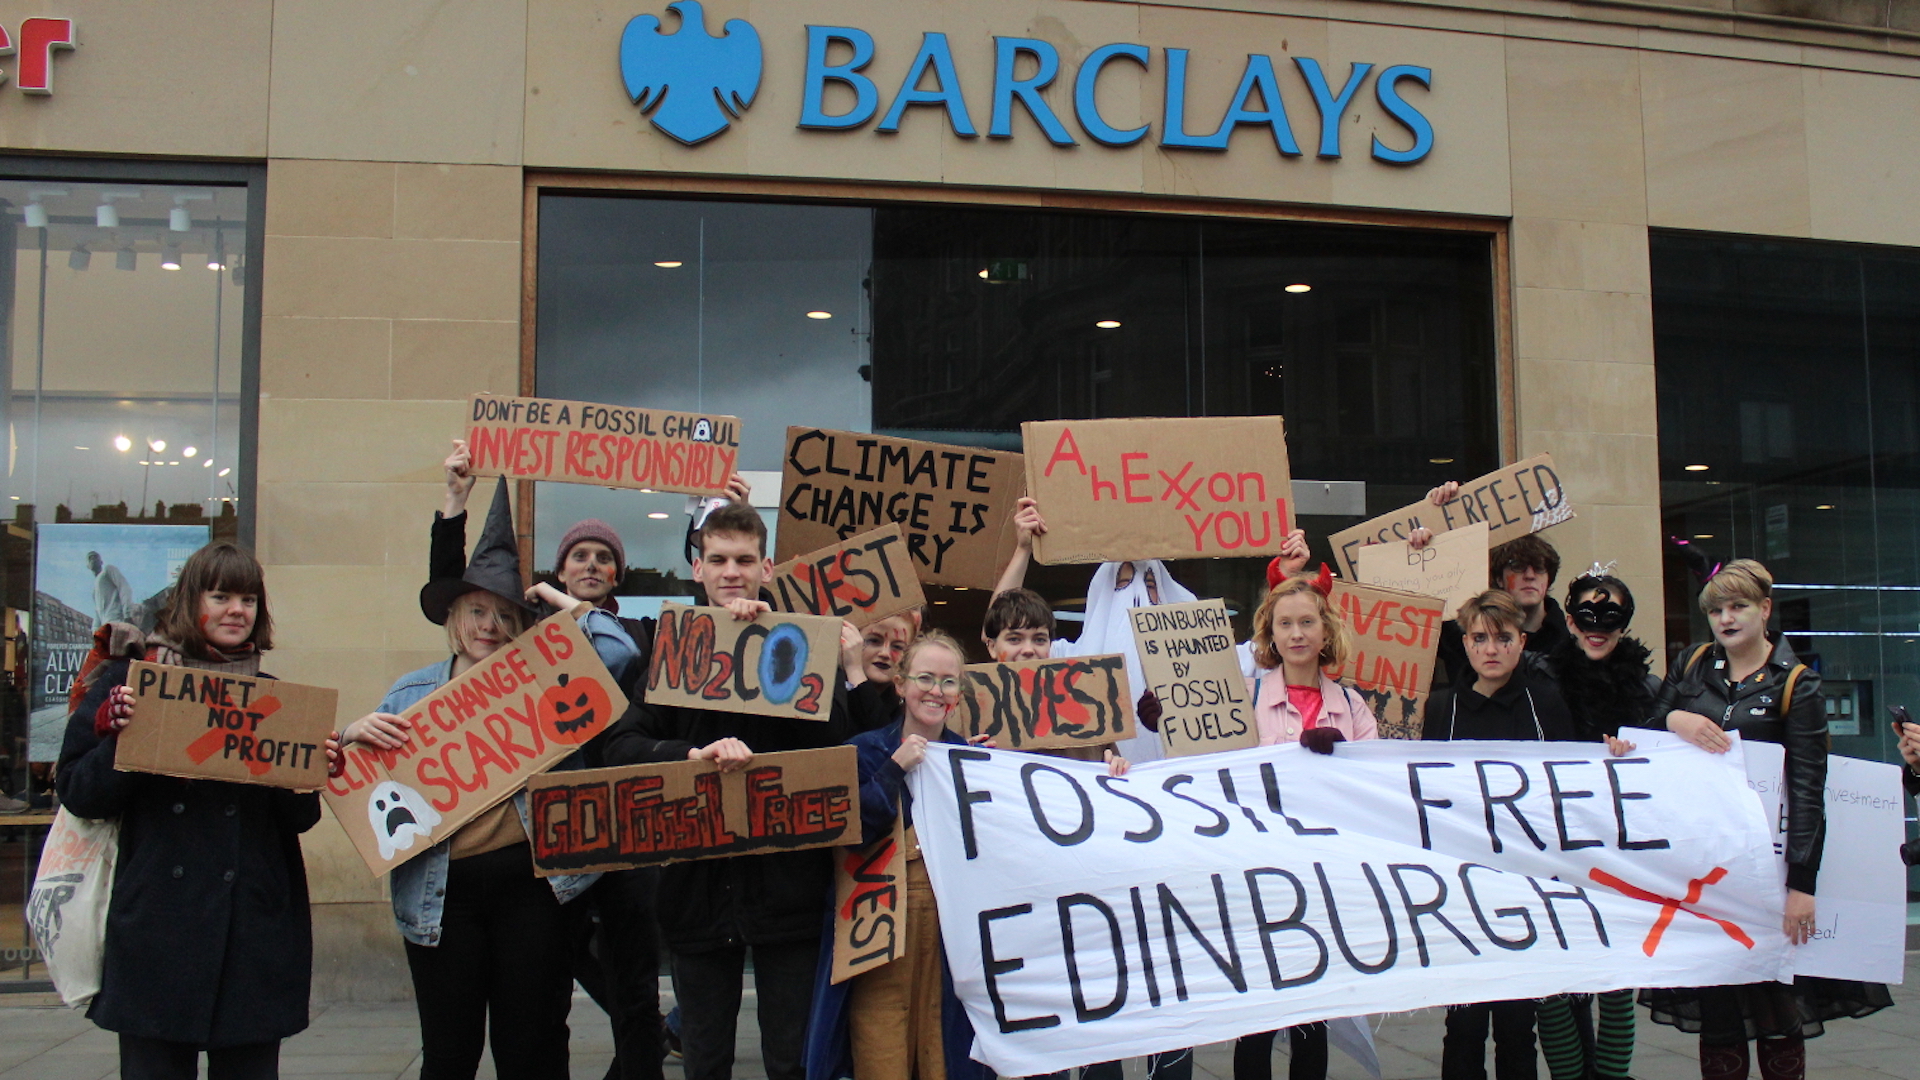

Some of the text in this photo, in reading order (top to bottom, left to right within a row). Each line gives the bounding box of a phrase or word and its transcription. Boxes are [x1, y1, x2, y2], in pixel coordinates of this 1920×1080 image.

[0, 16, 76, 94] r
[796, 24, 1434, 164] BARCLAYS
[526, 402, 552, 424] BE
[557, 405, 571, 424] A
[581, 406, 656, 435] FOSSIL
[468, 426, 735, 489] INVEST RESPONSIBLY
[789, 430, 996, 493] CLIMATE
[785, 481, 989, 535] CHANGE IS
[1184, 498, 1289, 551] YOU!
[1135, 608, 1227, 633] EDINBURGH
[1145, 635, 1230, 658] IS HAUNTED
[1173, 662, 1190, 678] BY
[139, 669, 256, 708] PLANET
[428, 648, 536, 733] CHANGE
[533, 622, 574, 667] IS
[1154, 678, 1243, 708] FOSSIL
[1355, 651, 1418, 699] UNI
[207, 708, 264, 731] NOT
[1164, 708, 1247, 746] FUELS
[224, 734, 317, 769] PROFIT
[416, 693, 546, 812] SCARY
[948, 749, 1671, 860] FOSSIL FREE
[978, 862, 1610, 1034] EDINBURGH
